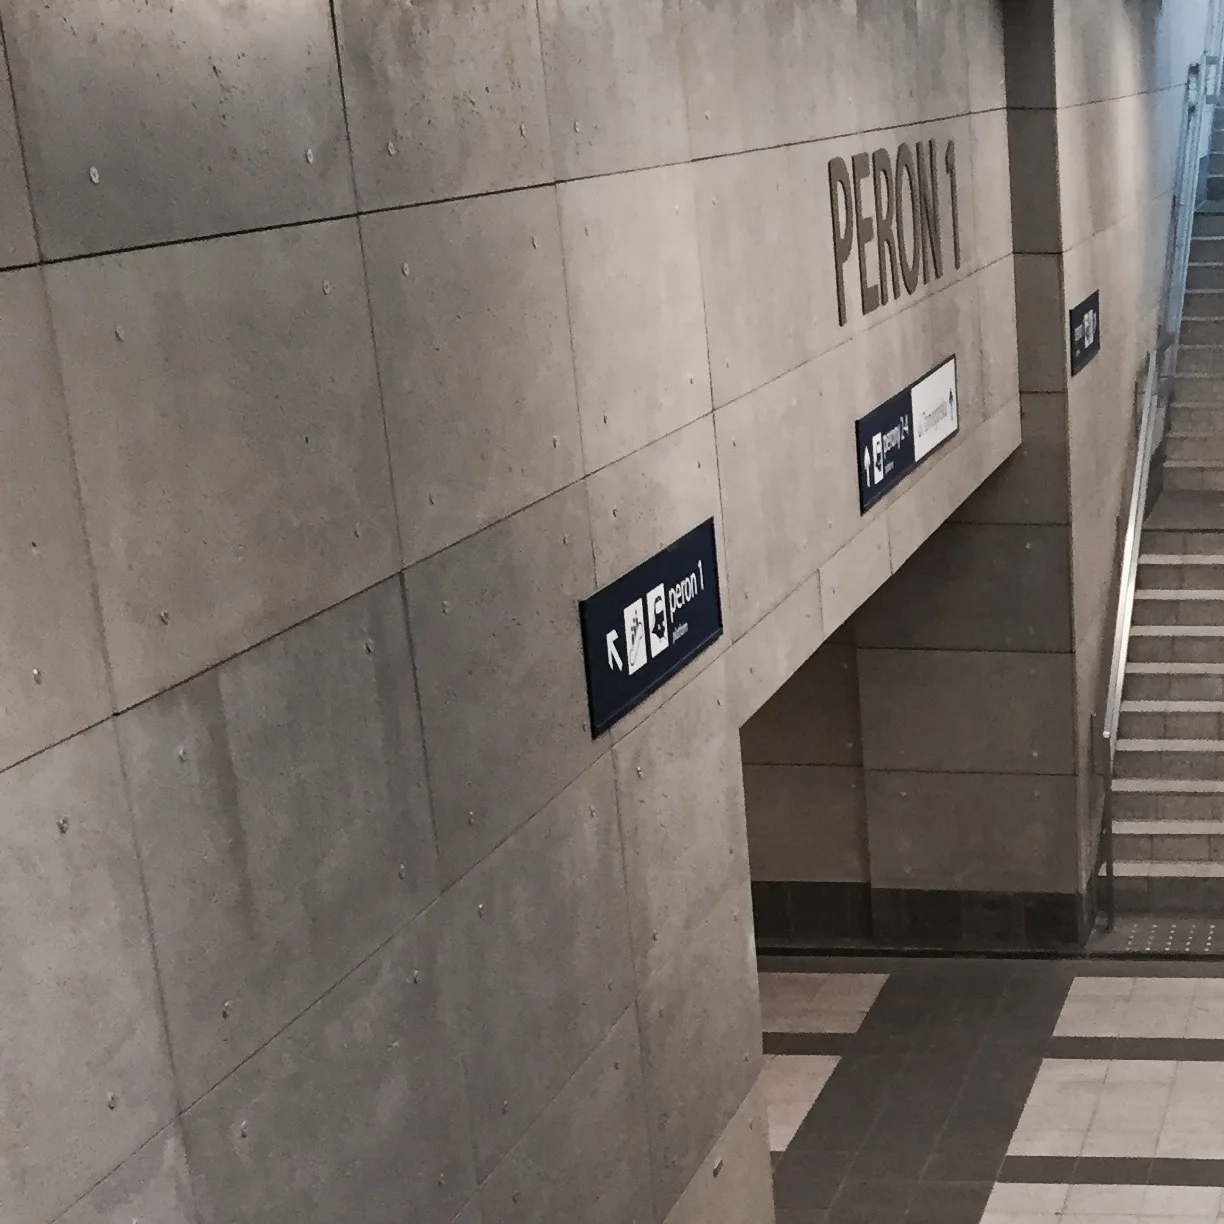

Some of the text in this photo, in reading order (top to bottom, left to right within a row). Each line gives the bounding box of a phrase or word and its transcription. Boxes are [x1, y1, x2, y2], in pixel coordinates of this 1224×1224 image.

[828, 138, 961, 327] PERON 1
[668, 559, 705, 623] peron 1
